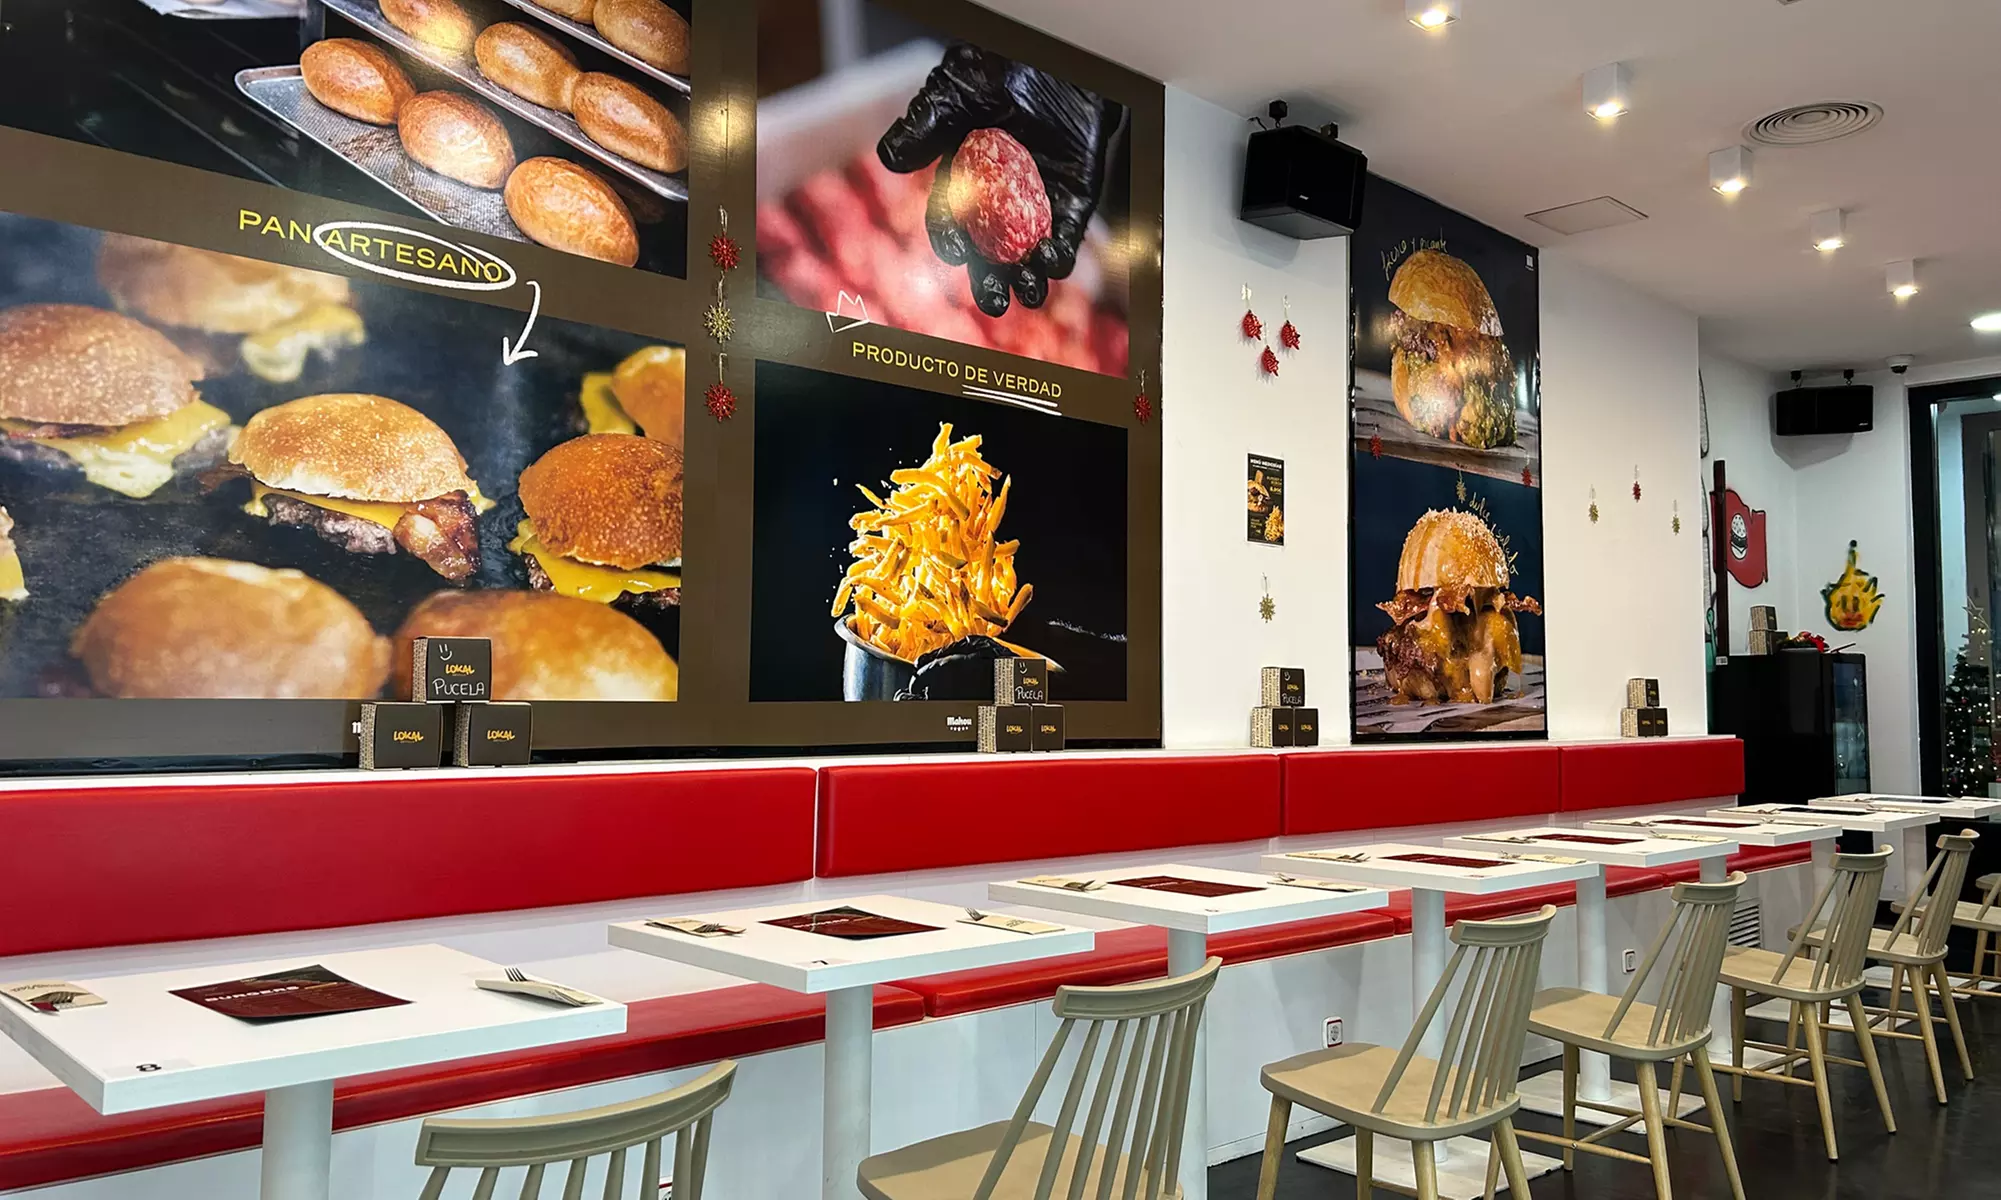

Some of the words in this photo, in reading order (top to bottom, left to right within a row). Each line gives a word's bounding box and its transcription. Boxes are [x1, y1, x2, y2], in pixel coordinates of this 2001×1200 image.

[239, 209, 311, 243] PAN
[325, 229, 503, 283] ARTESANO
[852, 341, 959, 378] PRODUCTO
[965, 365, 988, 384] DE
[992, 371, 1062, 398] VERDAD
[445, 663, 475, 675] LOKAL
[432, 677, 485, 696] PUCELA
[393, 730, 424, 742] LOKAL
[486, 729, 516, 741] LOKAL
